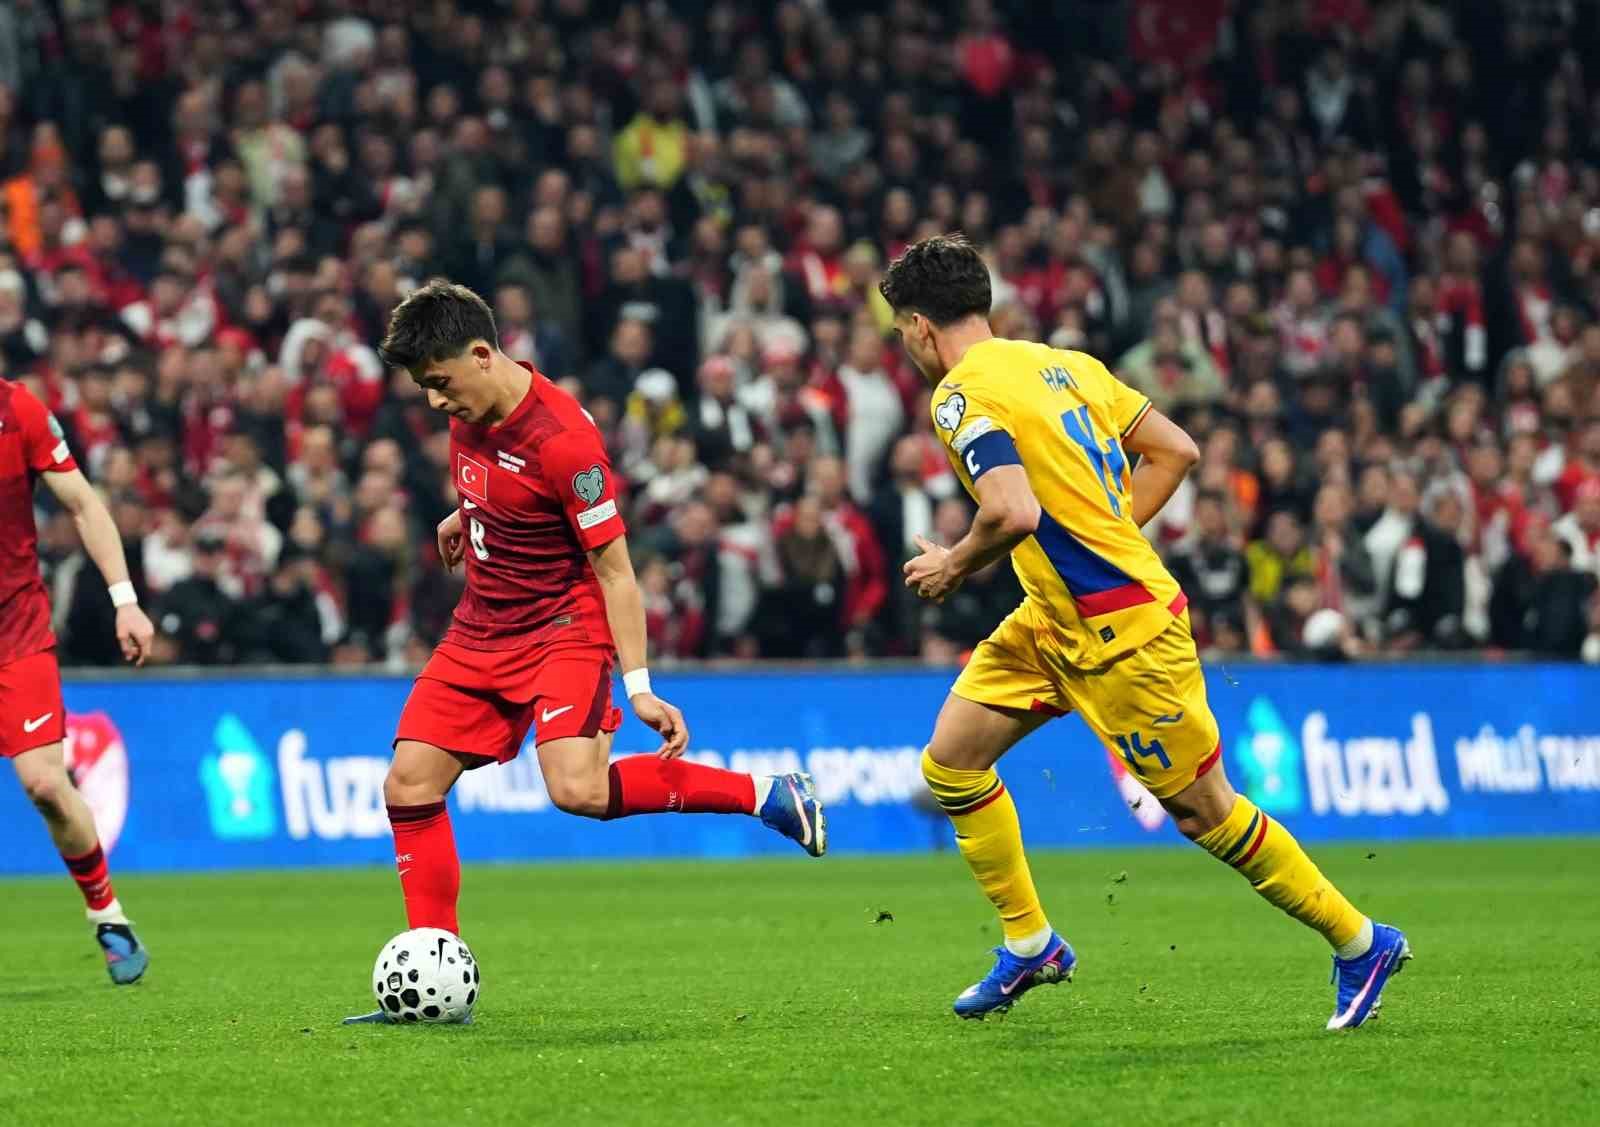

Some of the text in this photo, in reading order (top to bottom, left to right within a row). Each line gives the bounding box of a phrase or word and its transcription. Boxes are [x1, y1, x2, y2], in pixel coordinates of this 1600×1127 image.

[966, 449, 980, 475] C
[470, 516, 489, 560] 8
[1115, 731, 1172, 776] 14
[1303, 712, 1450, 816] fuzul
